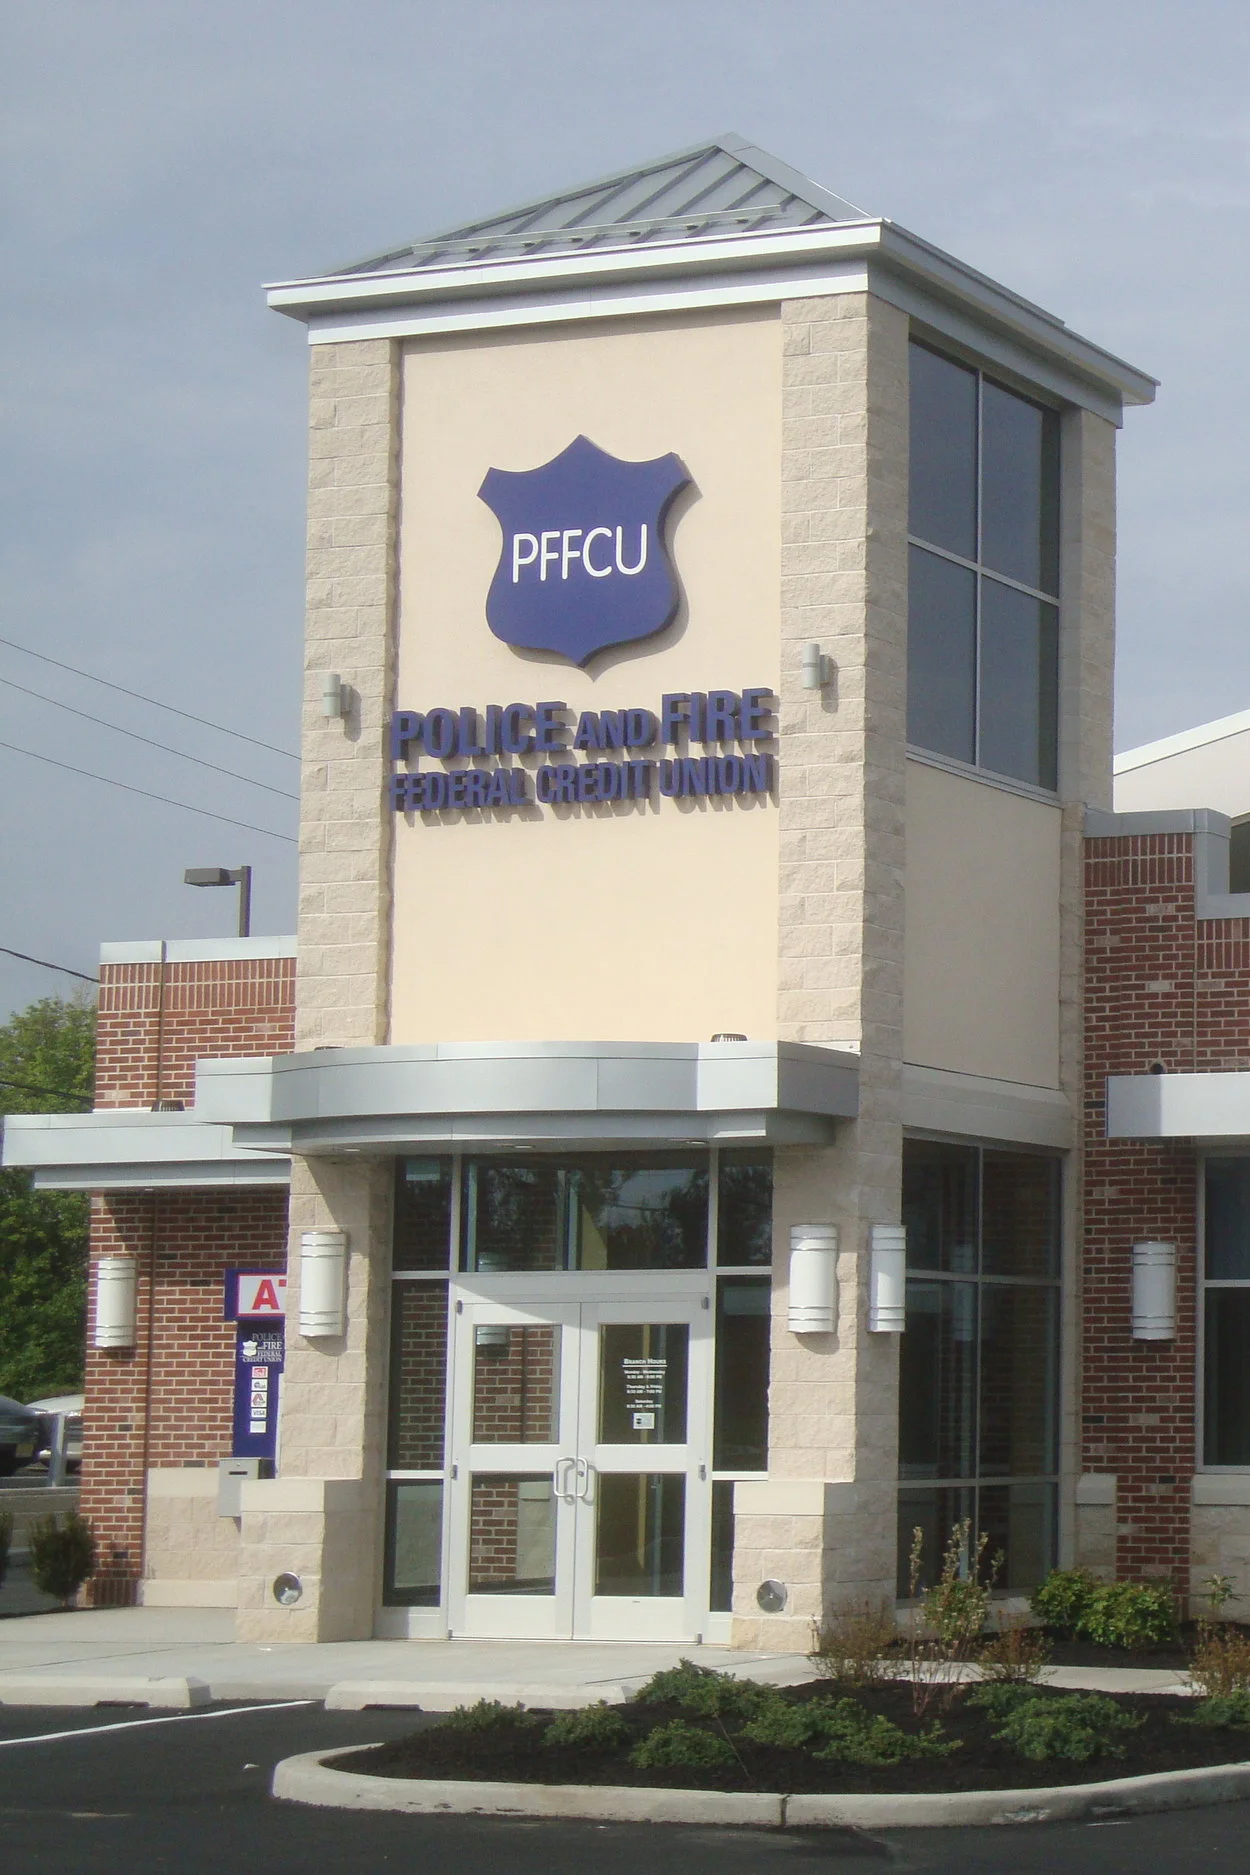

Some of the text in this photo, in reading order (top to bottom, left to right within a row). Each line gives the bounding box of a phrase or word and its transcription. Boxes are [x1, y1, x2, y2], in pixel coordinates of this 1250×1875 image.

[512, 523, 648, 584] PFFCU
[390, 687, 774, 761] POLICE AND FIRE
[388, 752, 776, 811] FEDERAL CREDIT UNION
[252, 1332, 283, 1341] POLICE
[263, 1341, 283, 1350] FIRE
